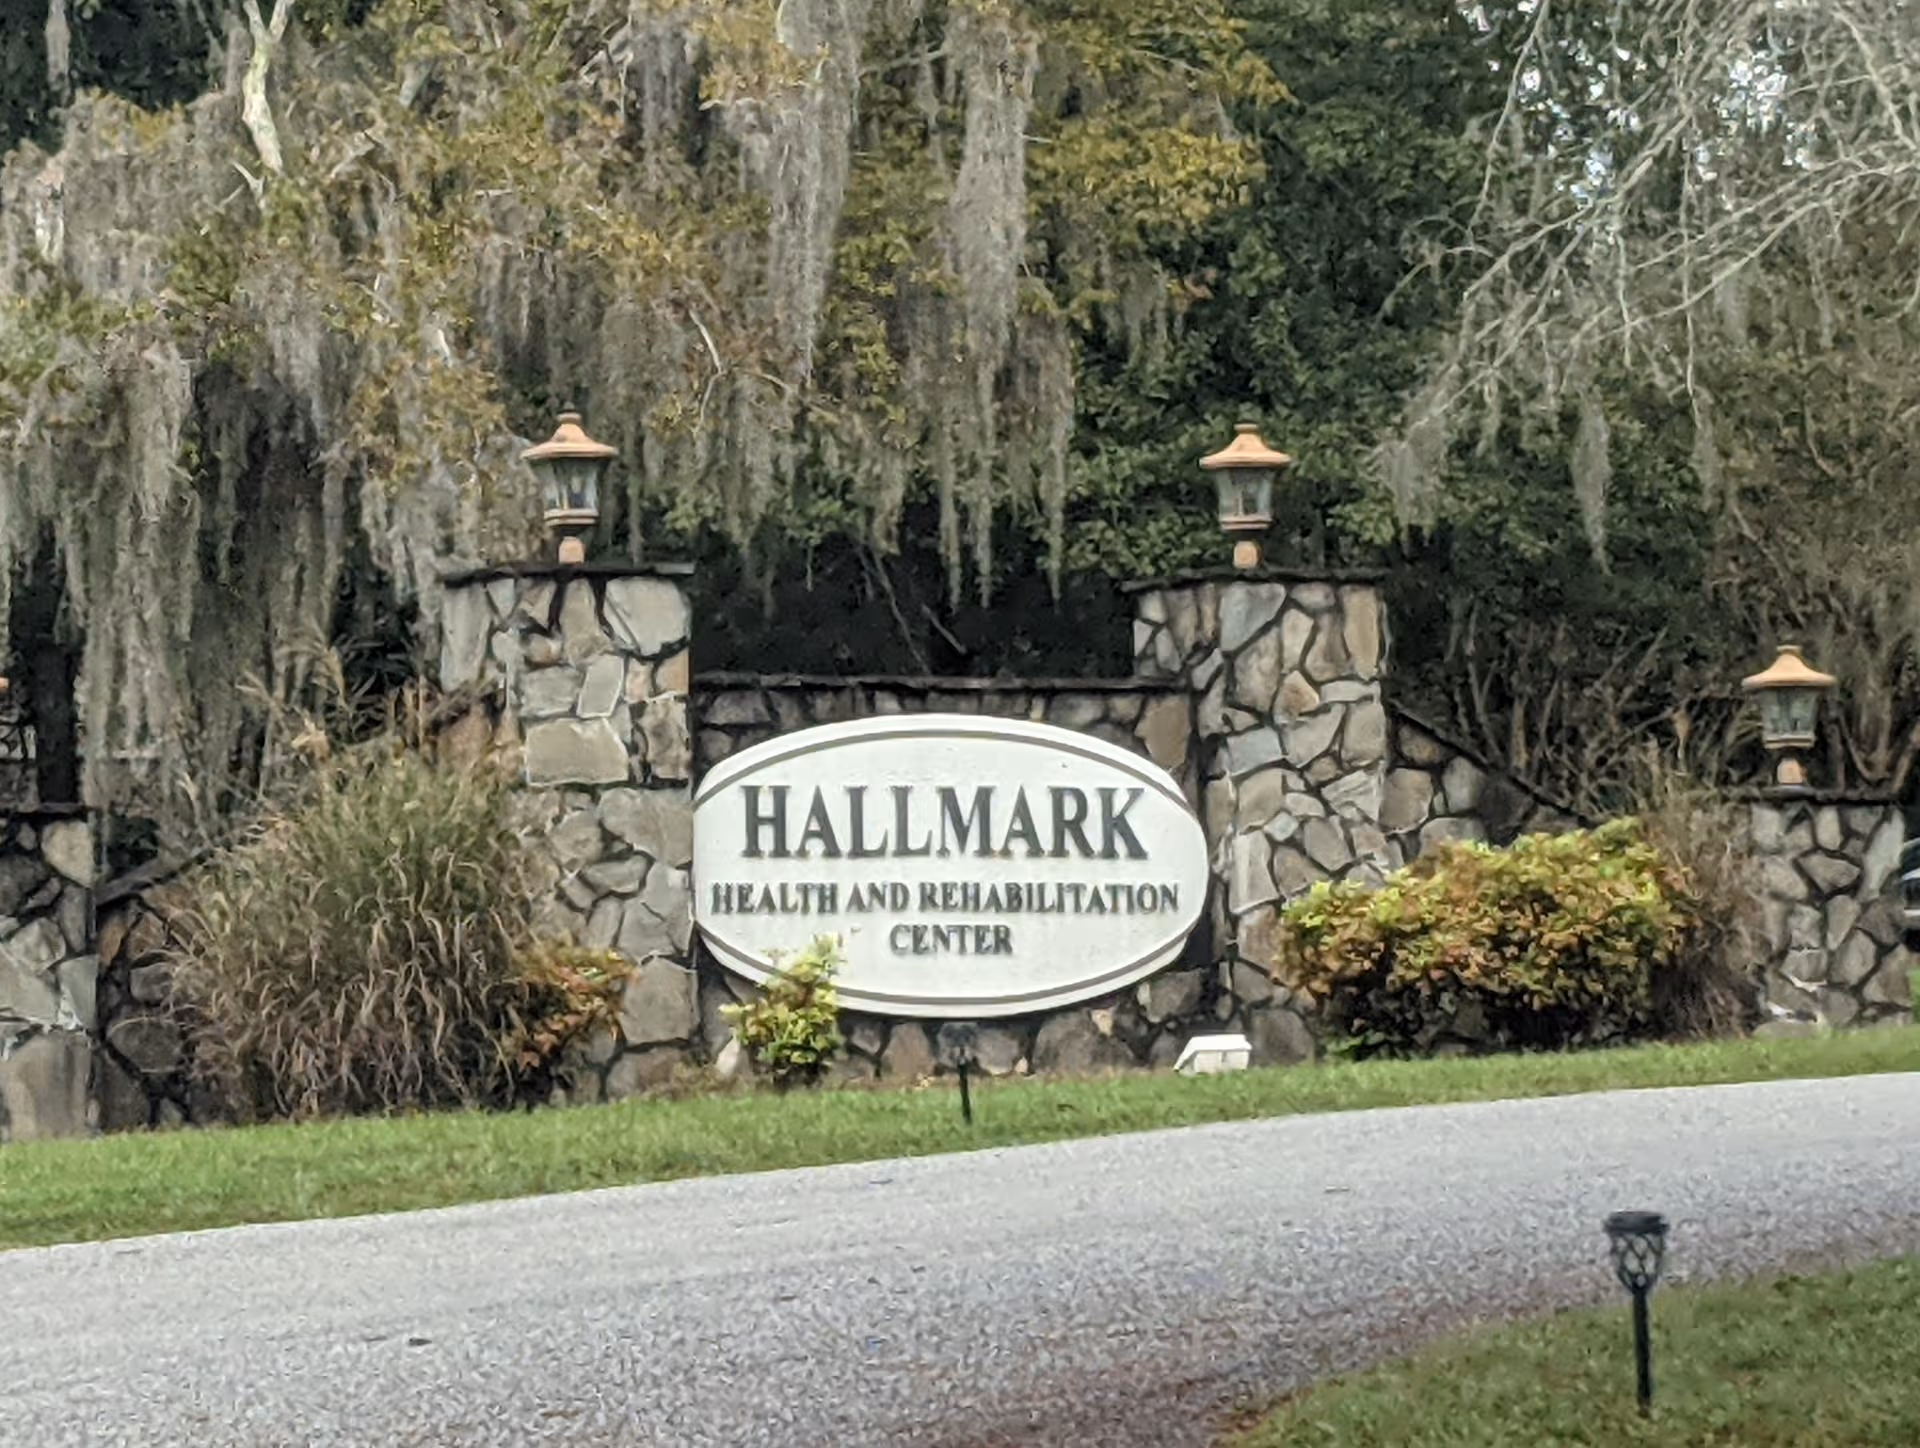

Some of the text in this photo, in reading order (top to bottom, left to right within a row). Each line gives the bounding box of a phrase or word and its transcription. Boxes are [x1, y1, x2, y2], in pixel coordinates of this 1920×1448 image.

[741, 785, 1148, 860] HALLMARK
[711, 882, 1179, 915] HEALTH AND REHABILITATION
[889, 923, 1014, 955] CENTER
